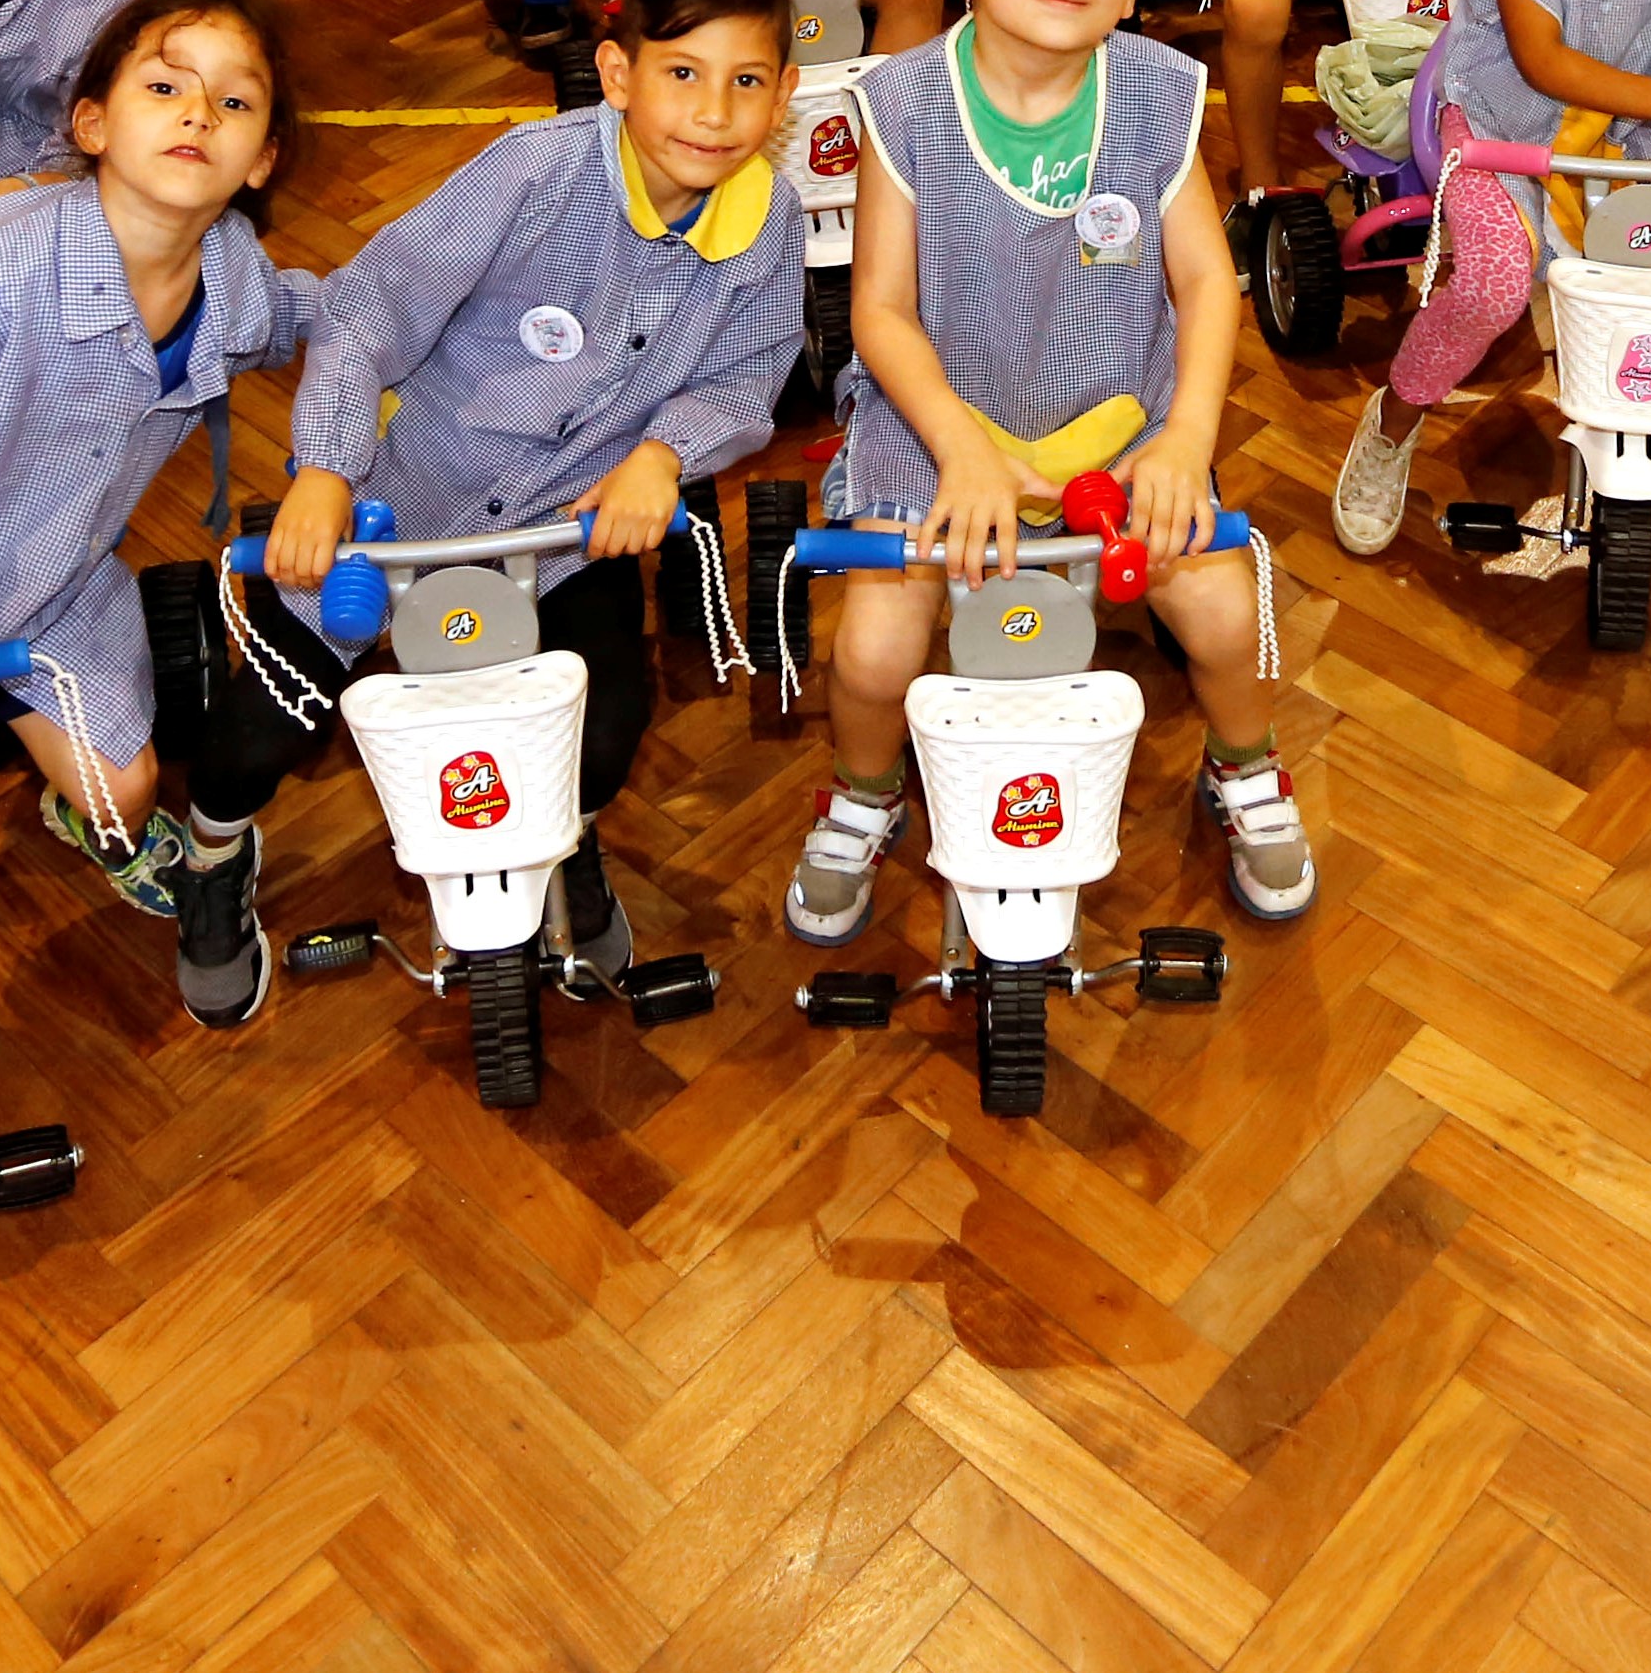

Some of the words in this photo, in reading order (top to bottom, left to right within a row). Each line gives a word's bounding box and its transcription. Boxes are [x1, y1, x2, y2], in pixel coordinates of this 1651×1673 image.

[450, 763, 499, 802] A
[446, 797, 508, 819] Alumine
[1005, 785, 1058, 819] A
[996, 817, 1060, 834] Alumine
